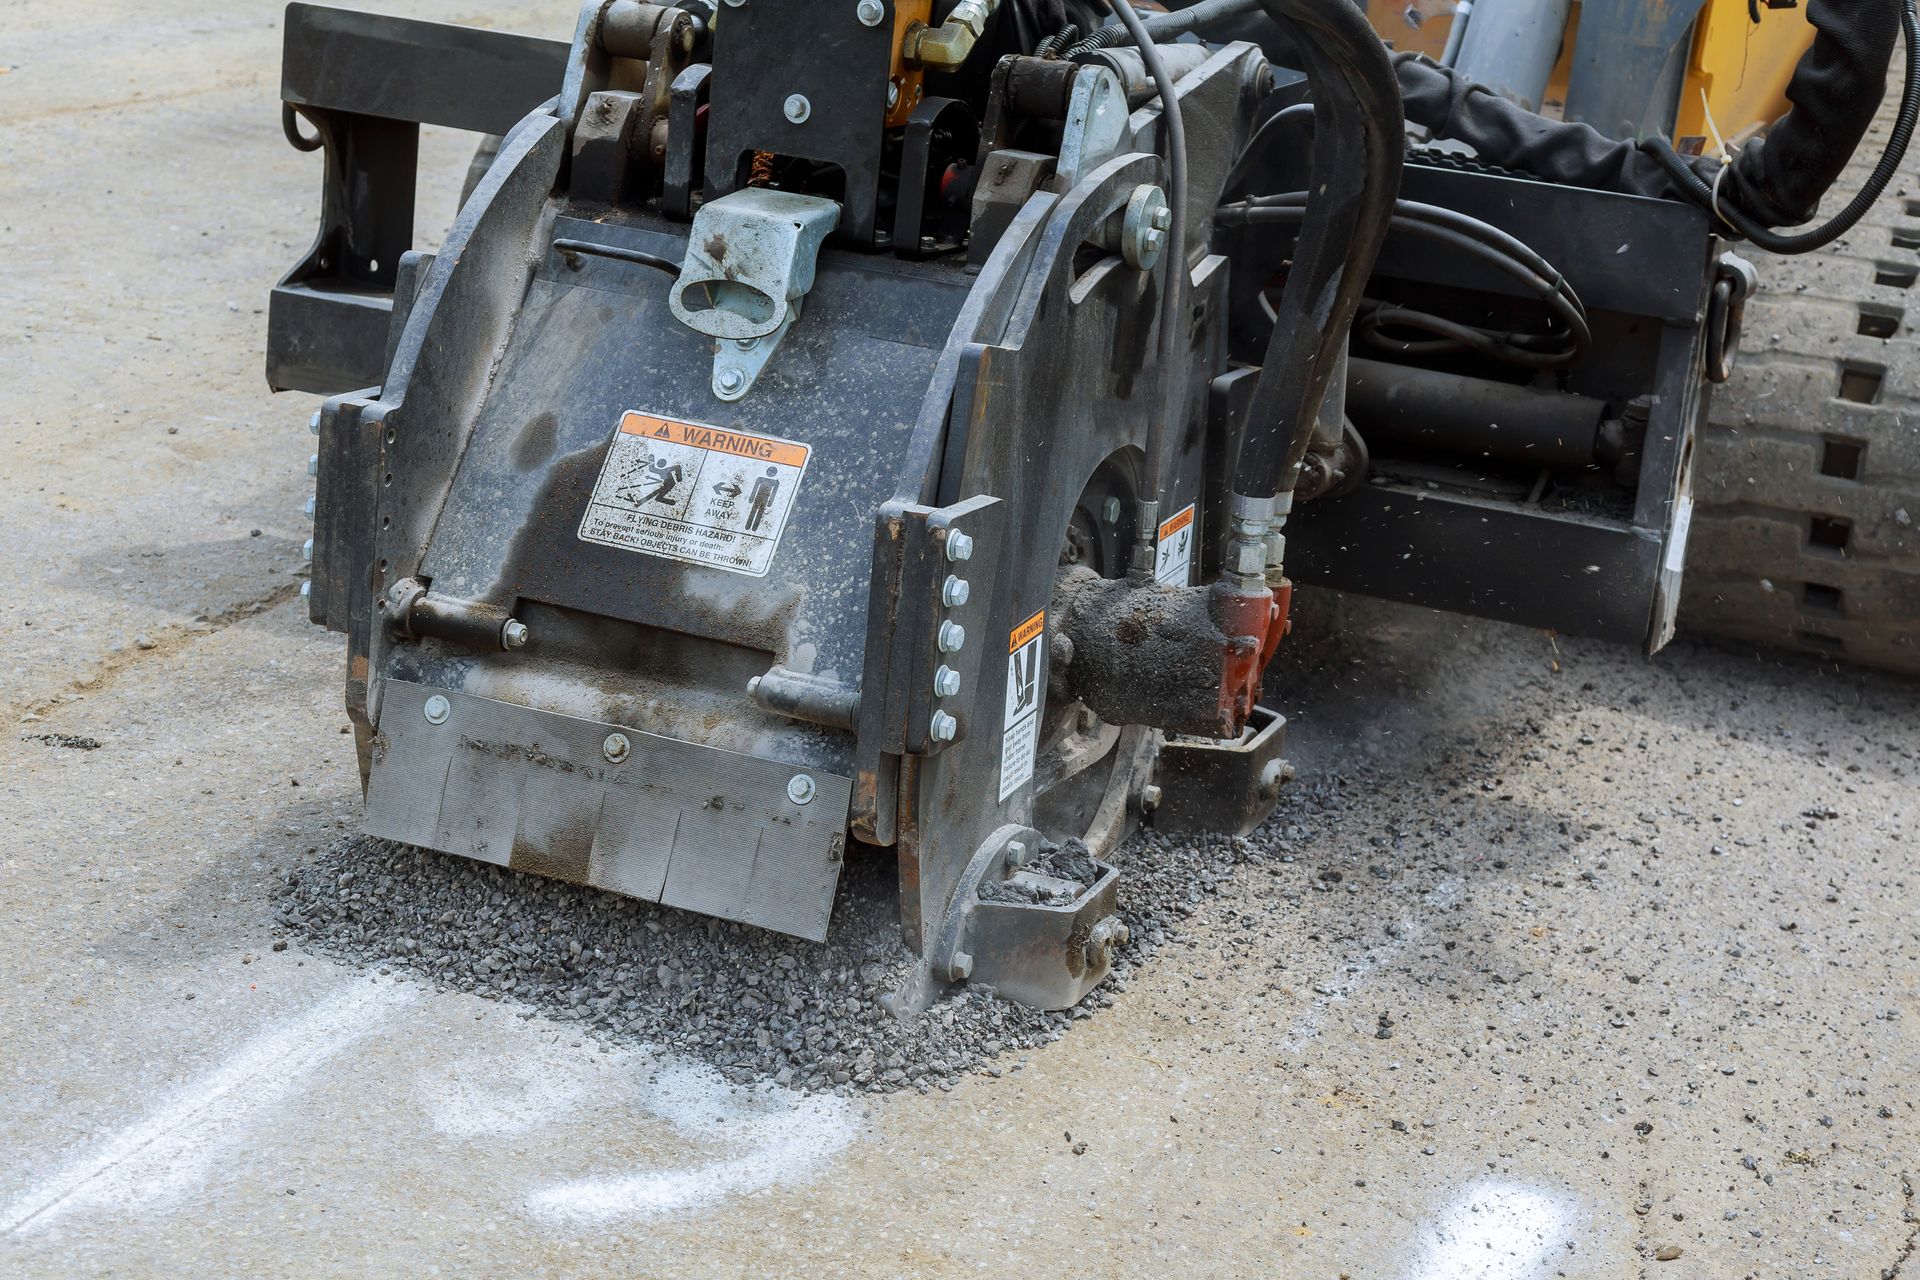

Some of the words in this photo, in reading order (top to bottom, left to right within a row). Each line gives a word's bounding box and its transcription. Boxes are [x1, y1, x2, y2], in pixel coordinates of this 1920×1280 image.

[682, 426, 774, 458] WARNING
[704, 508, 732, 520] AWAY
[710, 497, 735, 509] KEEP
[593, 517, 604, 526] To
[605, 521, 634, 534] prevent
[636, 528, 664, 539] serious
[665, 532, 688, 545] injury
[689, 538, 699, 546] or
[627, 513, 659, 527] FLYING
[660, 519, 694, 534] DEBRIS
[695, 527, 736, 543] HAZARD!
[590, 527, 612, 539] STAY
[612, 531, 640, 544] BACK!
[640, 537, 679, 553] OBJECTS
[679, 545, 698, 557] CAN
[698, 551, 711, 559] BE
[712, 552, 752, 568] THROWN!
[1017, 617, 1043, 642] WARNING
